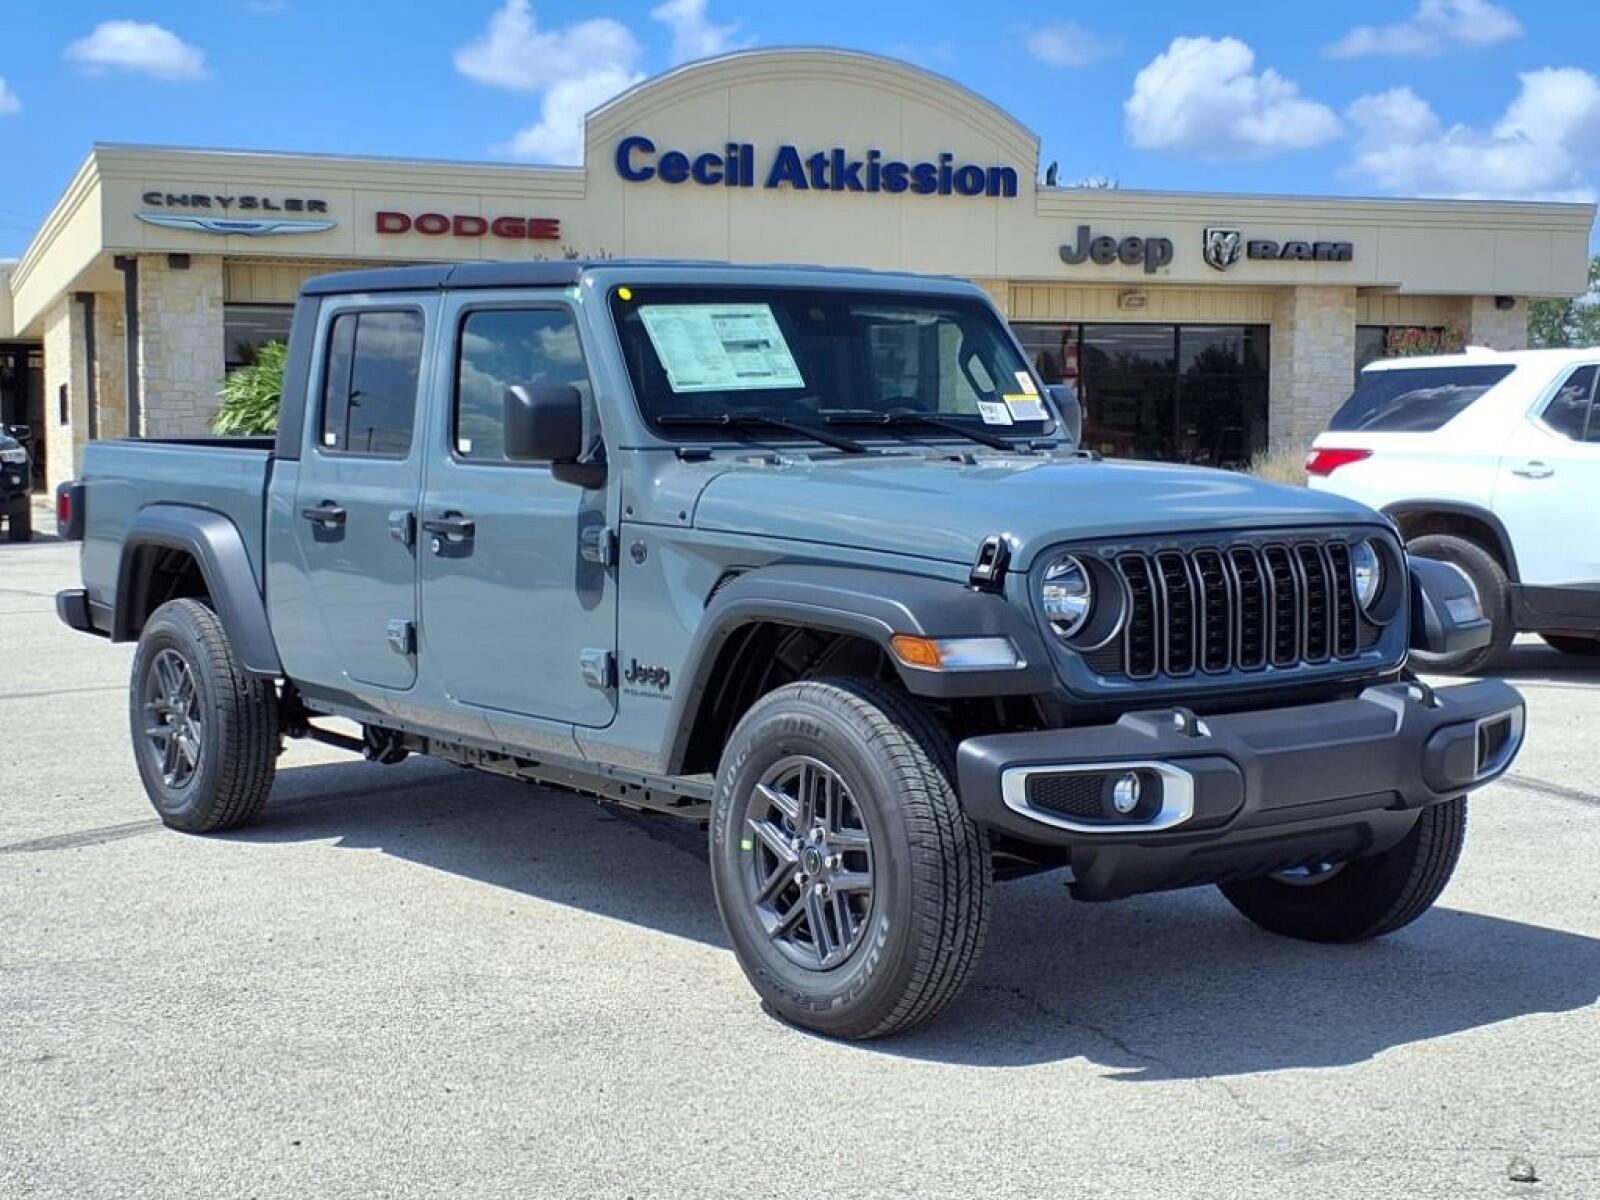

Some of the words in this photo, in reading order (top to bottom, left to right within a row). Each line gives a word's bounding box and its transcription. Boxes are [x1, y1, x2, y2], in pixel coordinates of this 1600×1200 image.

[614, 135, 754, 188] Cecil
[764, 145, 1018, 198] Atkission
[142, 191, 328, 213] CHRYSLER
[375, 211, 561, 239] DODGE
[1059, 225, 1173, 275] Jeep
[1247, 240, 1353, 261] RAM
[625, 658, 670, 691] Jeep
